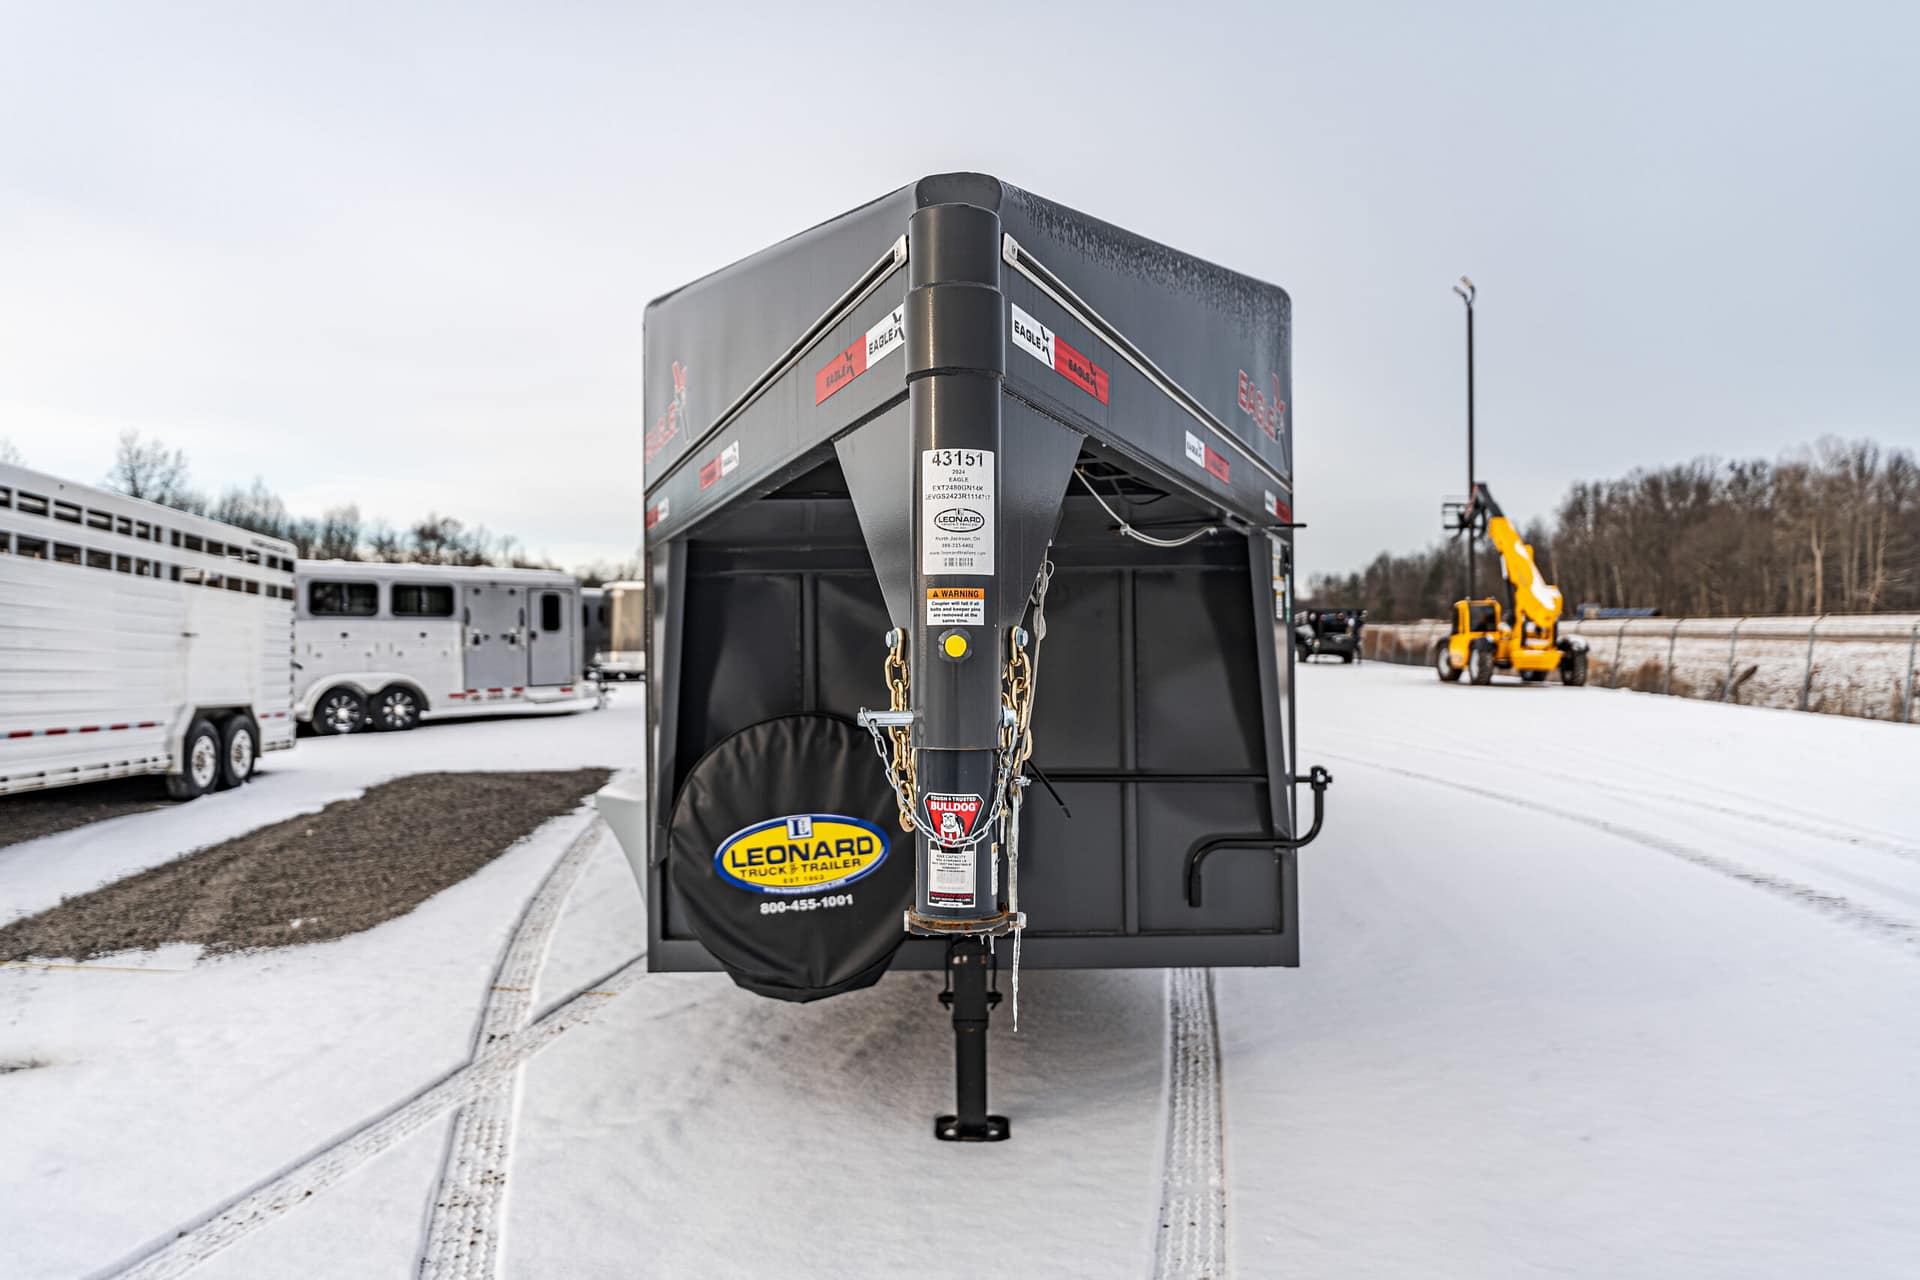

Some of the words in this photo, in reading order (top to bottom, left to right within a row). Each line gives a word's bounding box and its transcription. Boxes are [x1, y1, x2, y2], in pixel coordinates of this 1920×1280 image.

[932, 450, 983, 467] 43151
[930, 801, 976, 812] BULLDOG
[731, 836, 874, 868] LEONARD
[740, 864, 787, 878] TRUCK
[801, 858, 862, 872] TRAILER
[760, 894, 854, 915] 800-455-1001
